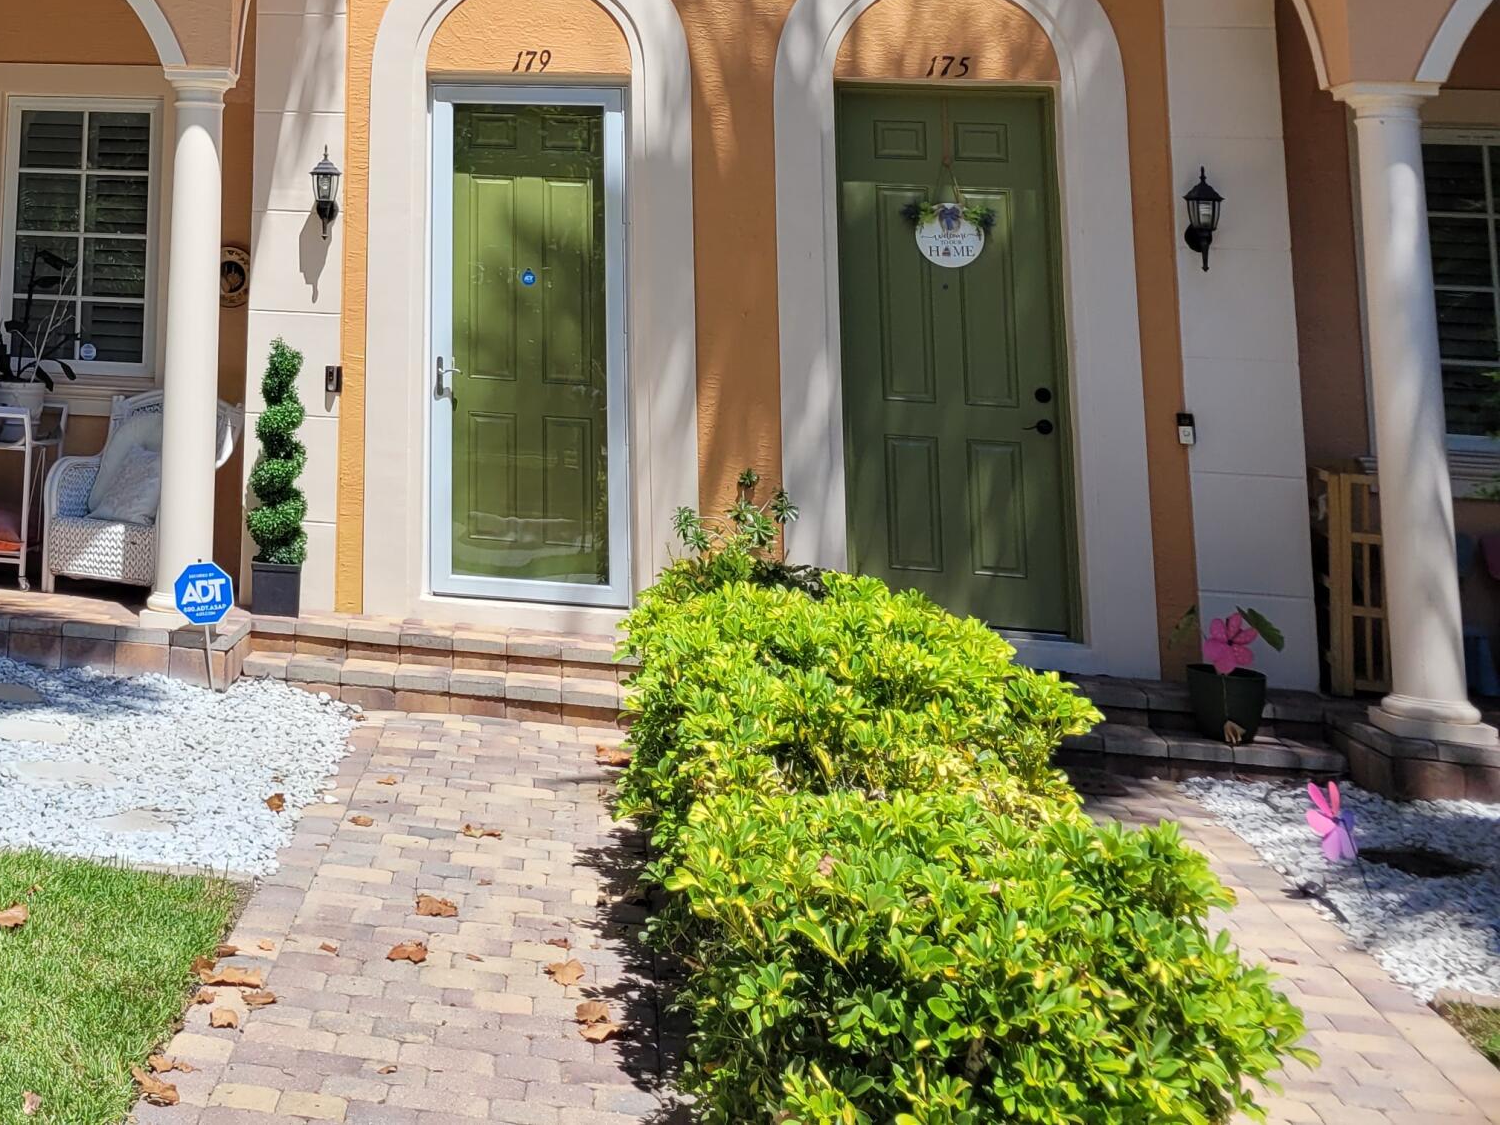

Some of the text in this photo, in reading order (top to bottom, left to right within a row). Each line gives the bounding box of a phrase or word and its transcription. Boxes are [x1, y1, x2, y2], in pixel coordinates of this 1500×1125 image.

[512, 49, 551, 73] 179
[926, 55, 971, 78] 175
[929, 245, 975, 257] HME
[181, 578, 226, 604] ADT
